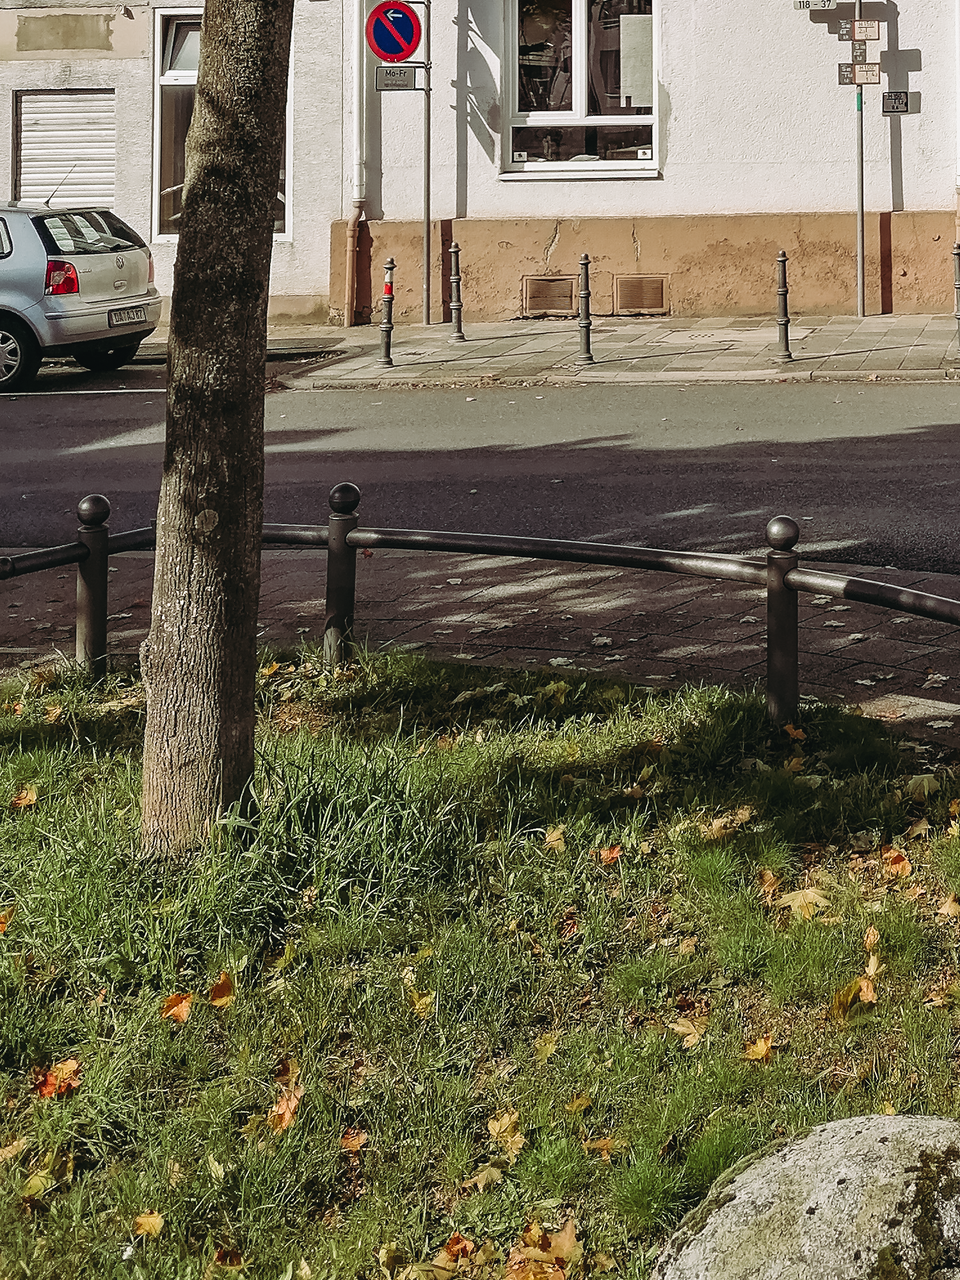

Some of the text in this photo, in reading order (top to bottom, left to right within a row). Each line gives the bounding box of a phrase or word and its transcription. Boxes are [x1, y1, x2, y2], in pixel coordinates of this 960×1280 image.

[798, 0, 811, 9] 118
[821, 0, 832, 8] 37
[385, 69, 407, 77] Mo-Fr
